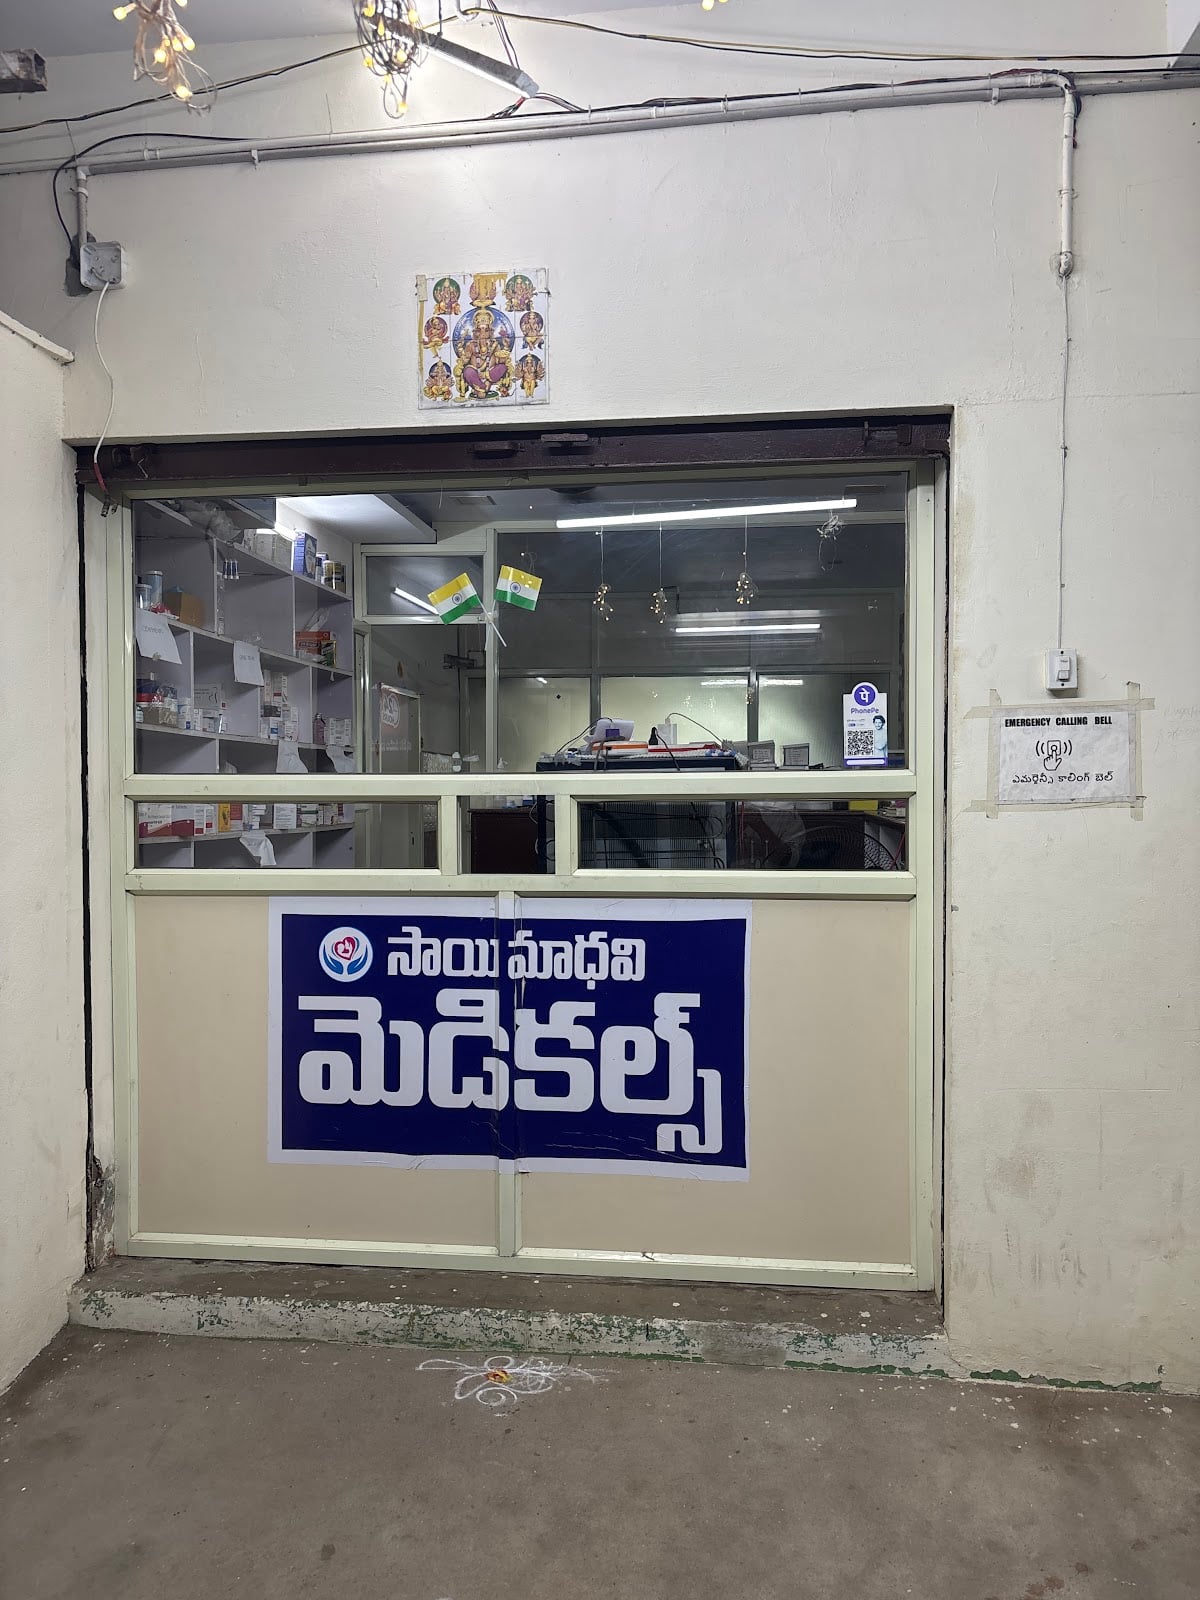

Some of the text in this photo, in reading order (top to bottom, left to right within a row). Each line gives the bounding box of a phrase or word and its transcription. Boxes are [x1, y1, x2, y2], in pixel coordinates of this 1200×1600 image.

[1004, 716, 1112, 728] EMERGENCY CALLING BELL
[1058, 771, 1090, 783] కాలింగ్
[1095, 770, 1114, 782] బెల్
[387, 925, 646, 990] సాయి మాధవి
[298, 988, 723, 1154] మెడికల్స్
